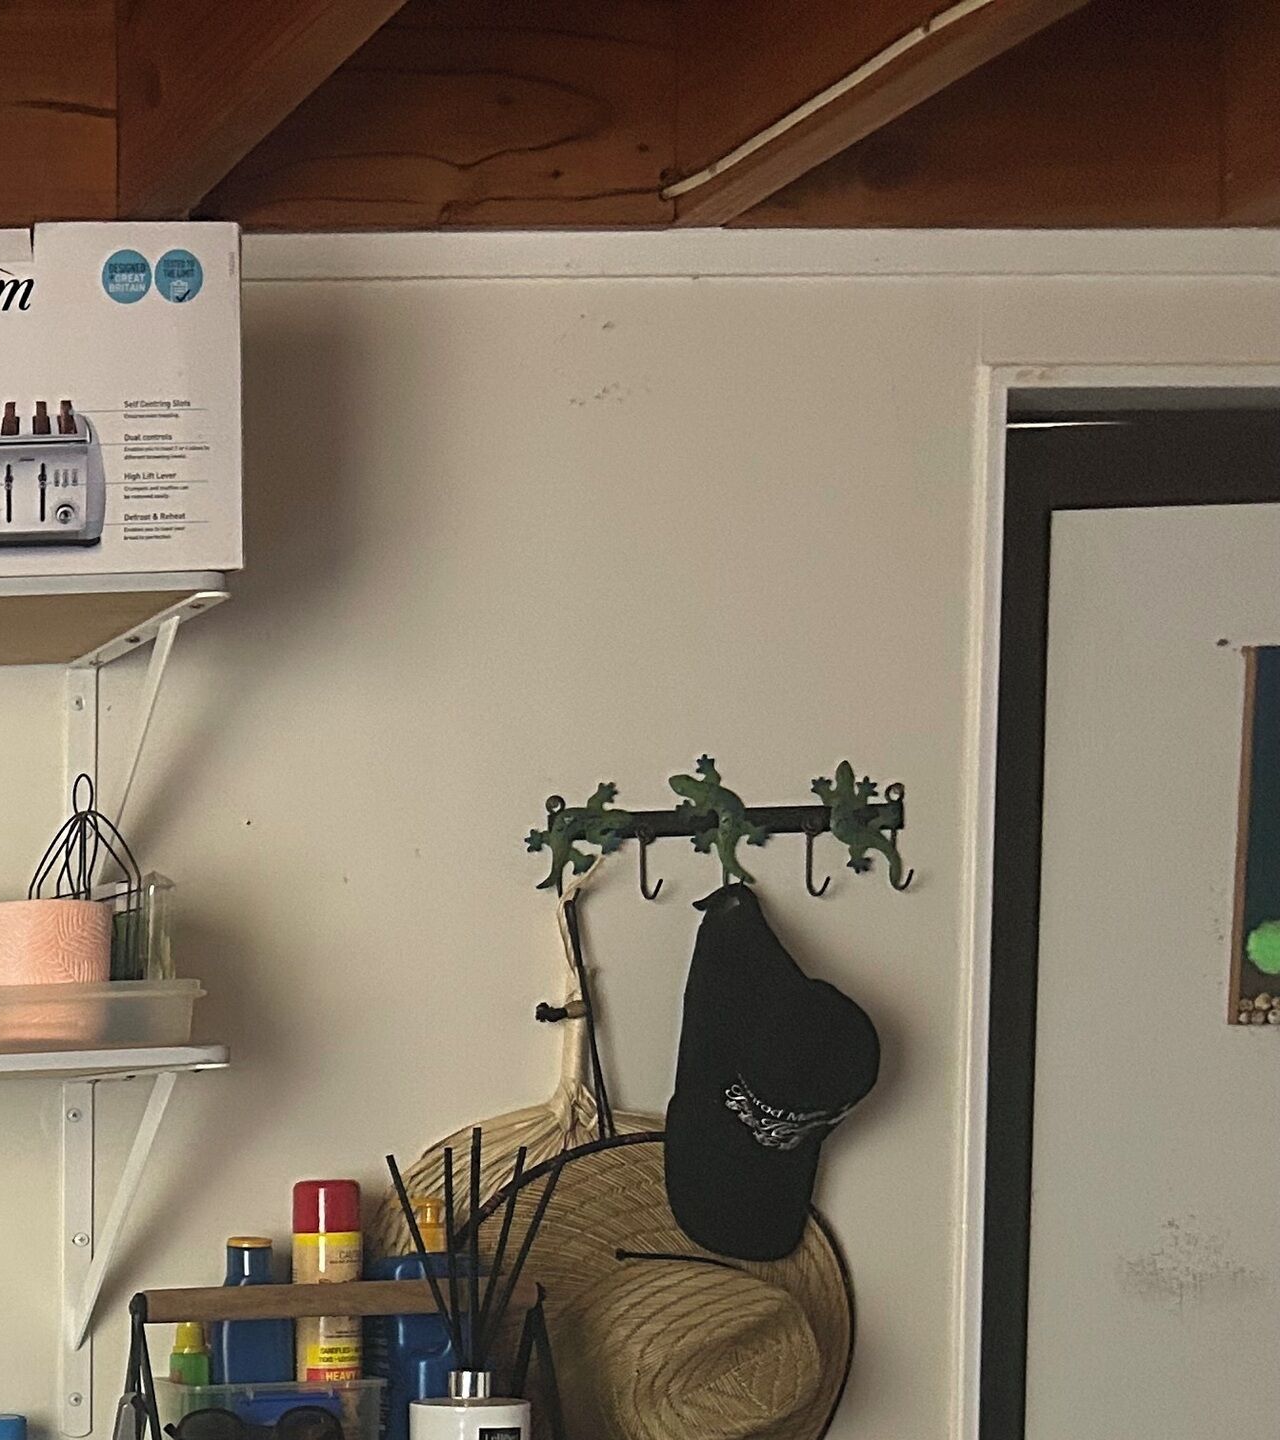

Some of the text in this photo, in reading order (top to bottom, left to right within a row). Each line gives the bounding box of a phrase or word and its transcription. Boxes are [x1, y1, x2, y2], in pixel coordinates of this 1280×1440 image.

[114, 273, 146, 283] GREAT
[108, 283, 146, 293] BRITAIN
[124, 472, 141, 481] High
[325, 1370, 358, 1383] HEAVY
